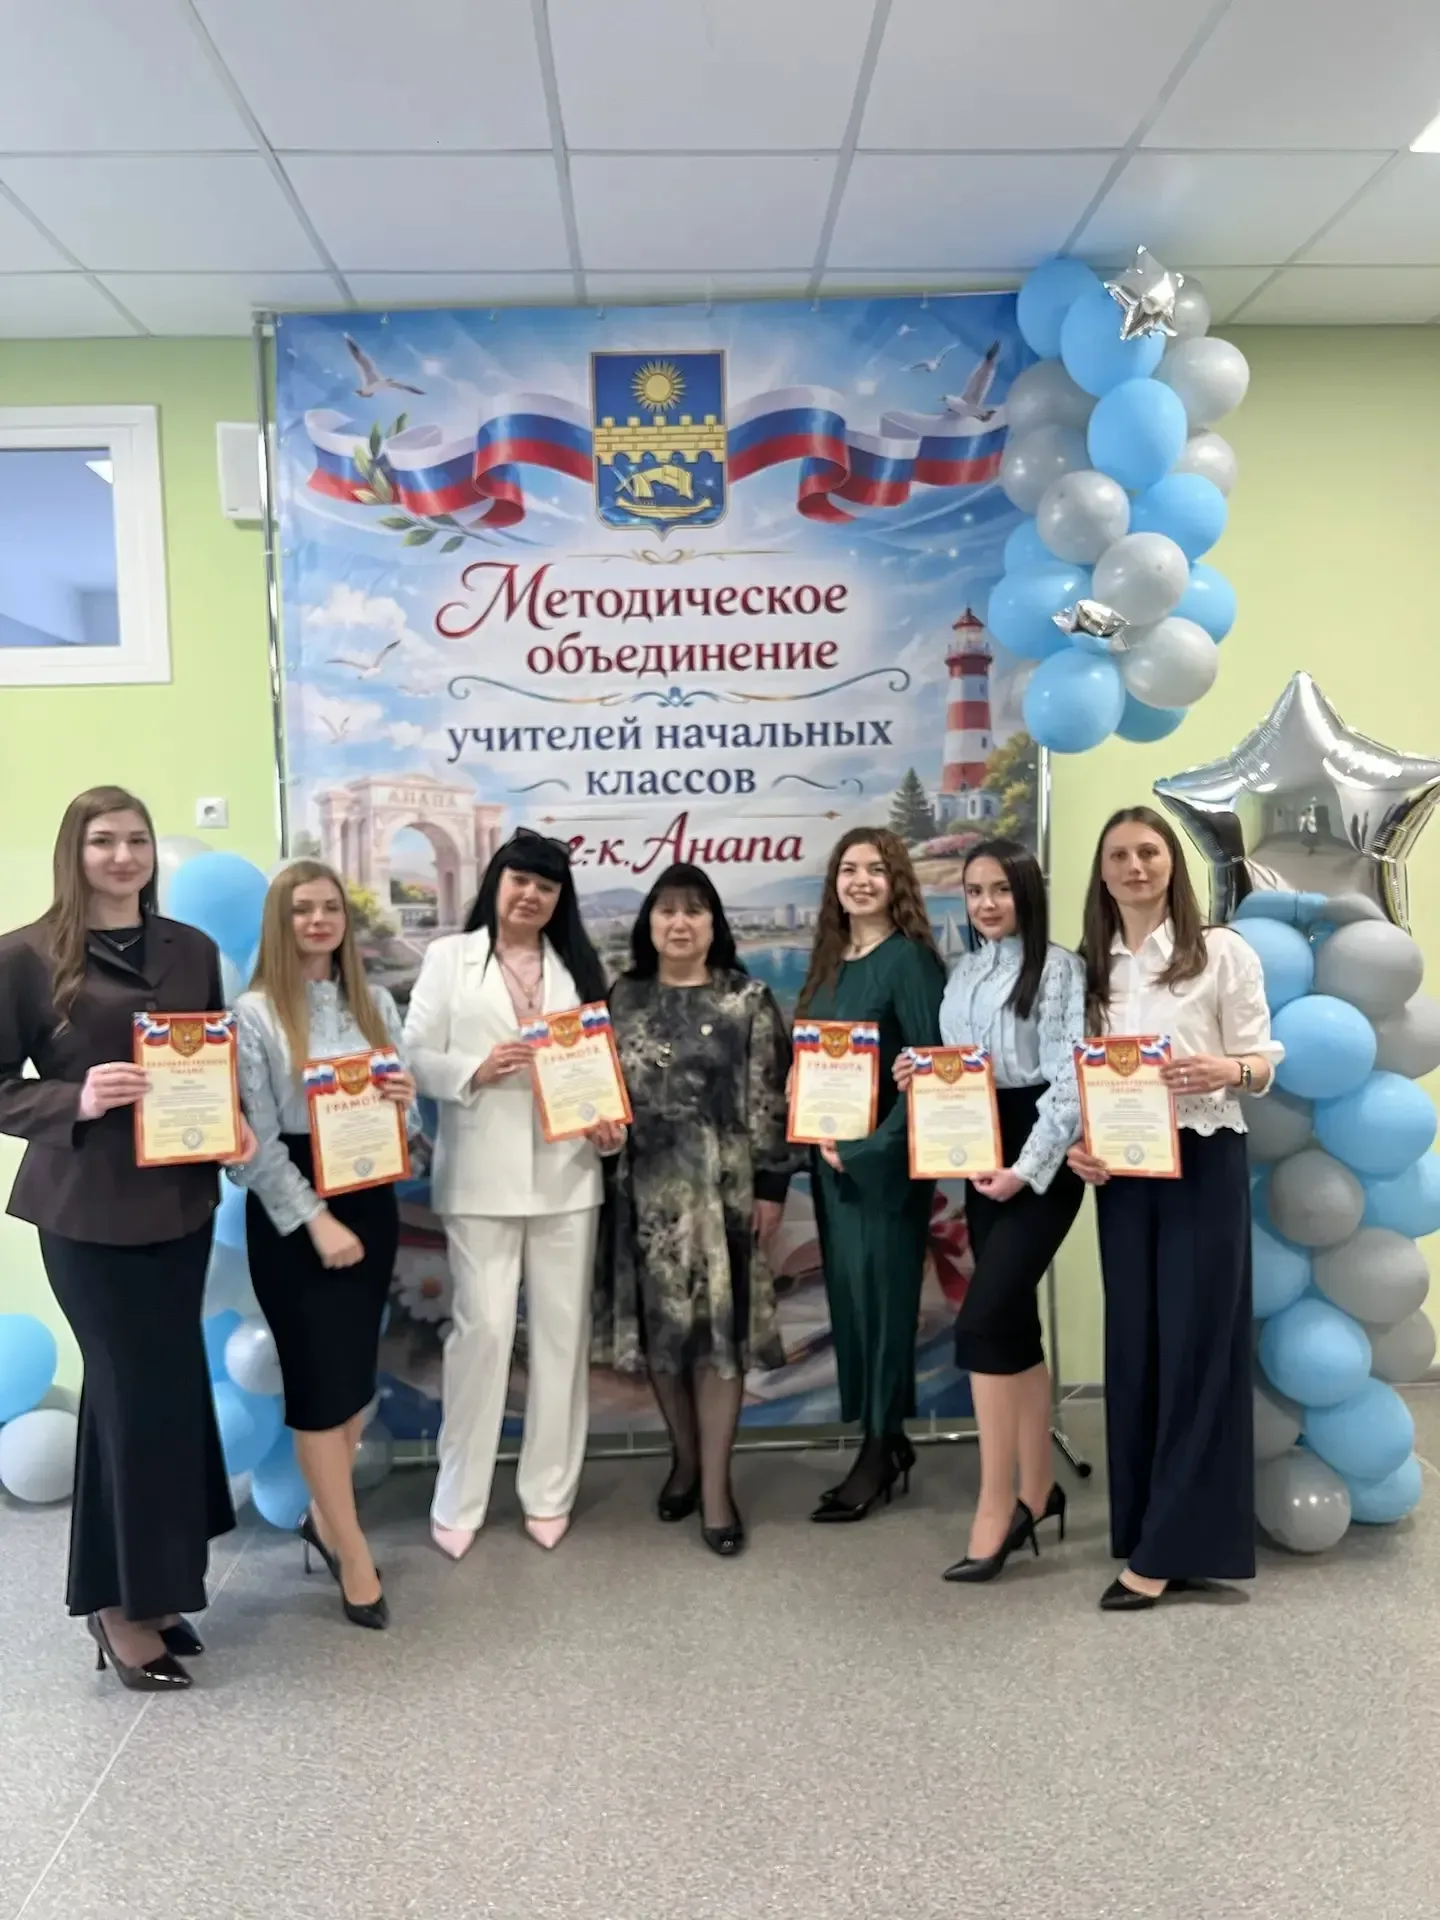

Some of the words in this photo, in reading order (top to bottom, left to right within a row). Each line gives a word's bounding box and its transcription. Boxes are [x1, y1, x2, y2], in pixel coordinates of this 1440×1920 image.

[434, 561, 848, 639] Методическое
[526, 631, 839, 679] объединение
[447, 716, 641, 763] учителей
[656, 719, 893, 749] начальных
[586, 768, 756, 796] классов
[631, 811, 806, 875] Анапа
